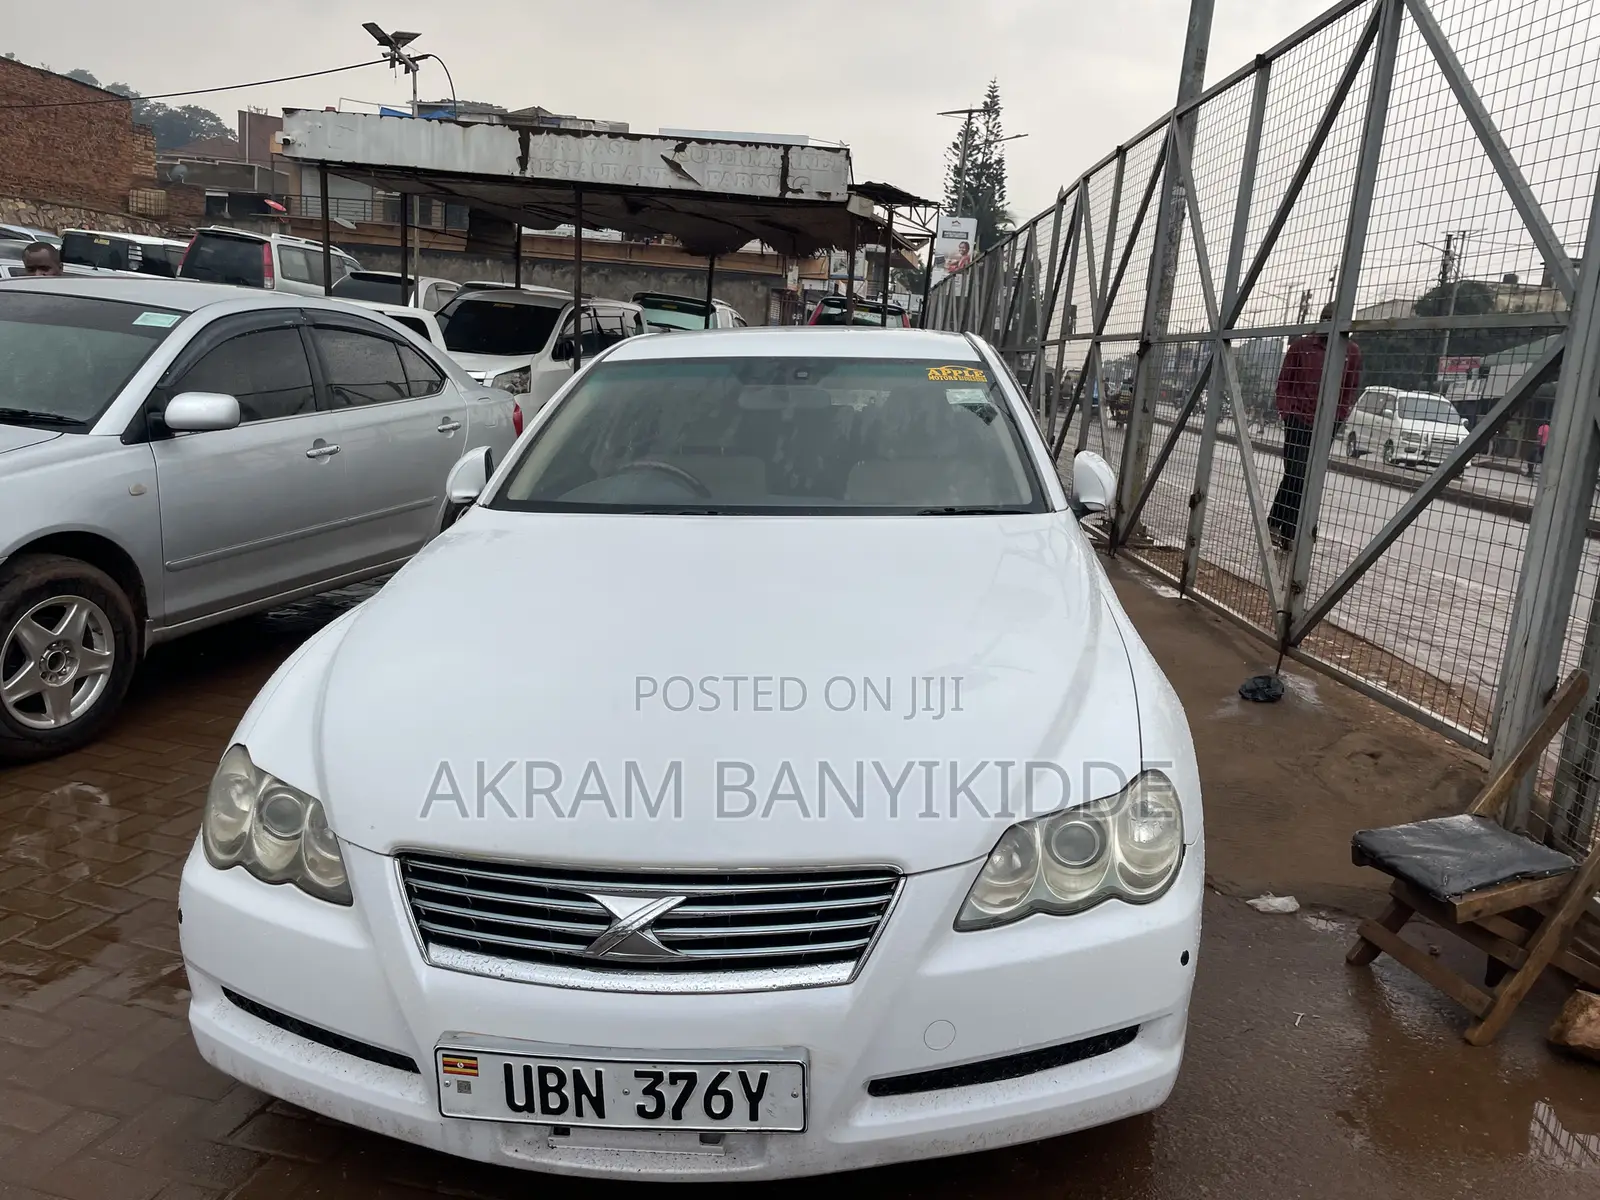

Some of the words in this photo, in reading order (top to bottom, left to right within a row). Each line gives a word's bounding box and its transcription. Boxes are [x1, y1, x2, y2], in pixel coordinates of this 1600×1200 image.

[527, 157, 669, 185] RESTAURANT
[928, 368, 985, 378] APPLE
[503, 1062, 606, 1119] UBN
[634, 1069, 769, 1122] 376Y
